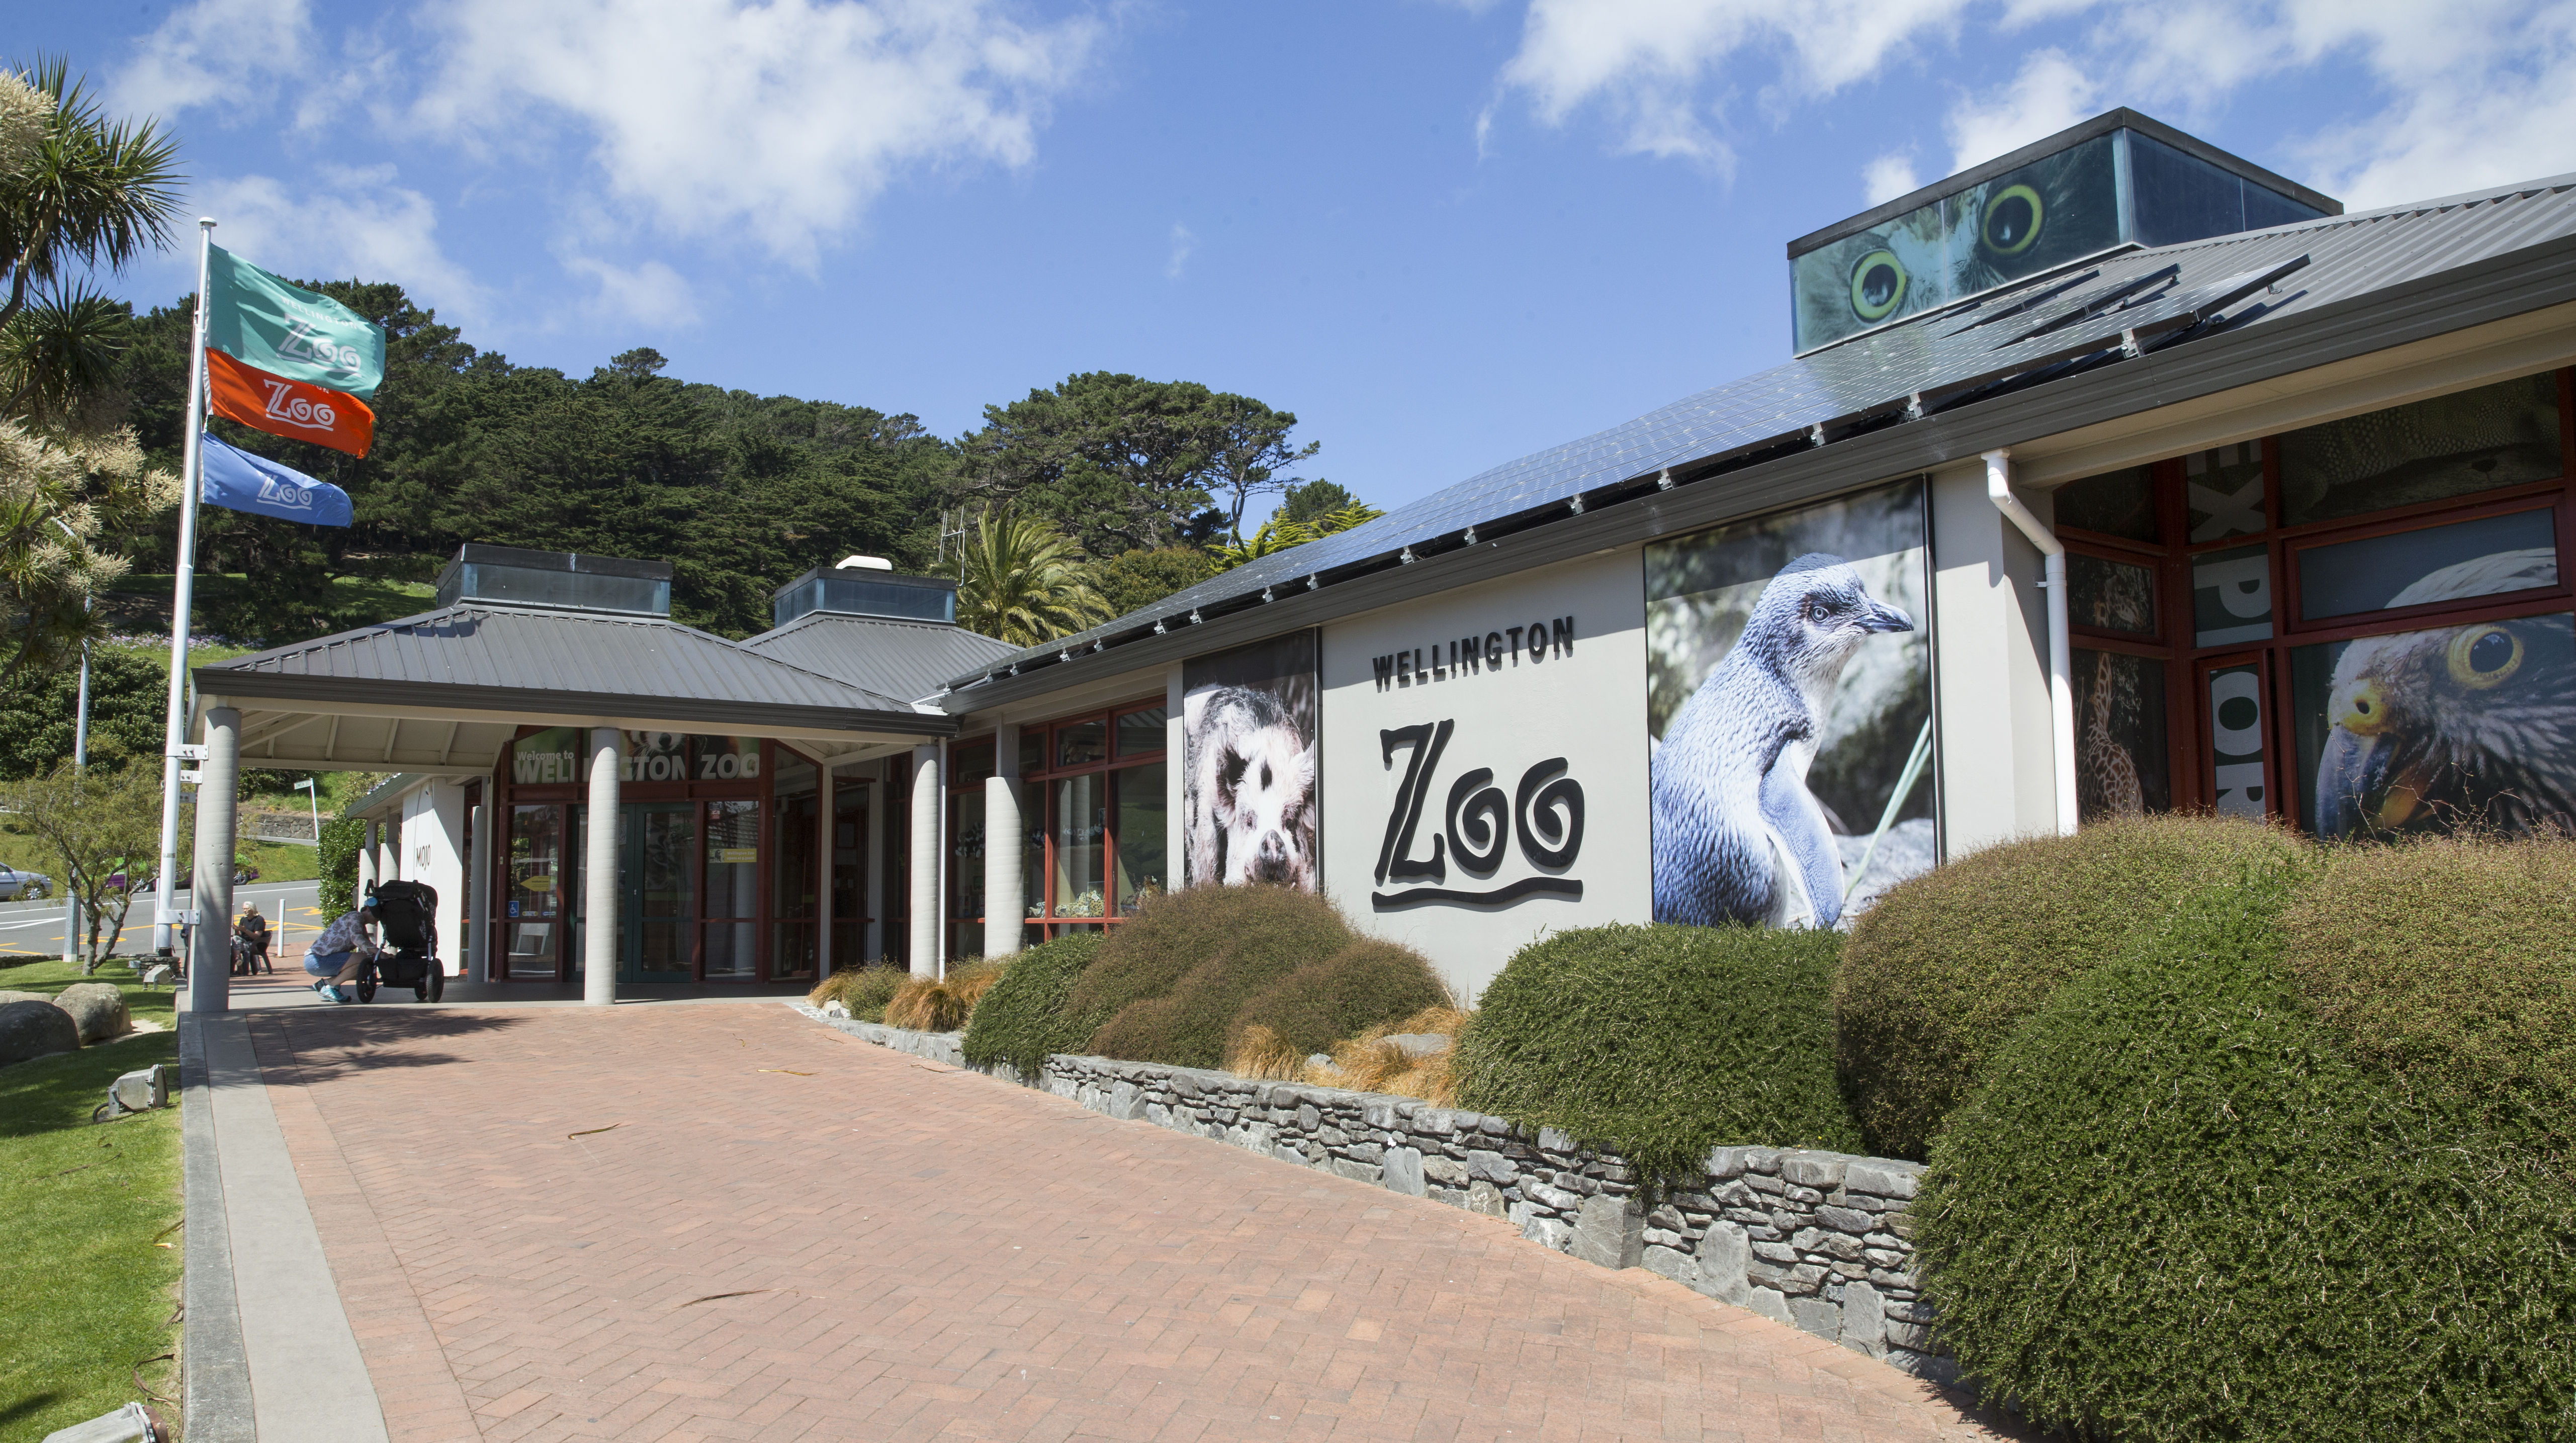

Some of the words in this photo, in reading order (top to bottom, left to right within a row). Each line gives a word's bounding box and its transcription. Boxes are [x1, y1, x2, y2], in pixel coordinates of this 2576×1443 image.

[281, 296, 357, 329] WELLINGTON
[278, 312, 361, 371] Zoo
[263, 379, 335, 426] Zoo
[1372, 616, 1574, 686] WELLINGTON
[516, 751, 561, 760] Welcome
[564, 750, 574, 759] to
[701, 753, 760, 780] ZOO
[1374, 718, 1585, 880] Zoo
[416, 844, 431, 871] MOJO
